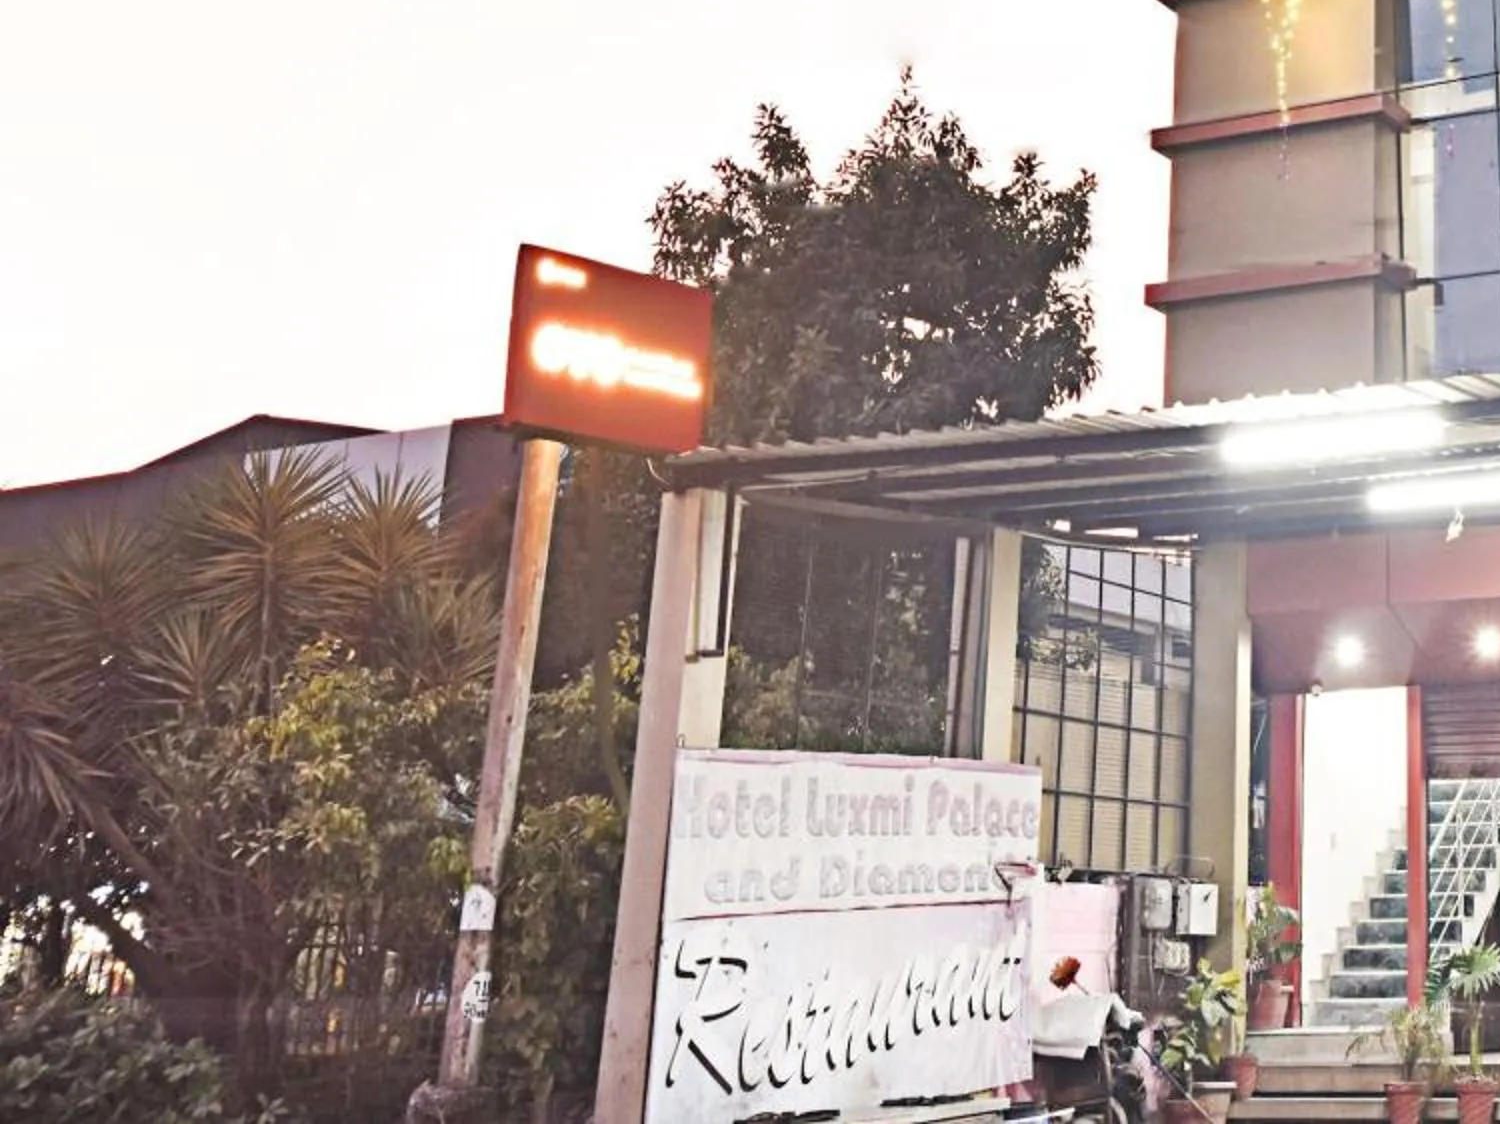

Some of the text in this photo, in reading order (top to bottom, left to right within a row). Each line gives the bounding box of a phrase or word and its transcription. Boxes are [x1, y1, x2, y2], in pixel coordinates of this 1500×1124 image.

[674, 774, 1039, 840] Hotel Luxmi Palace
[702, 854, 803, 904] and
